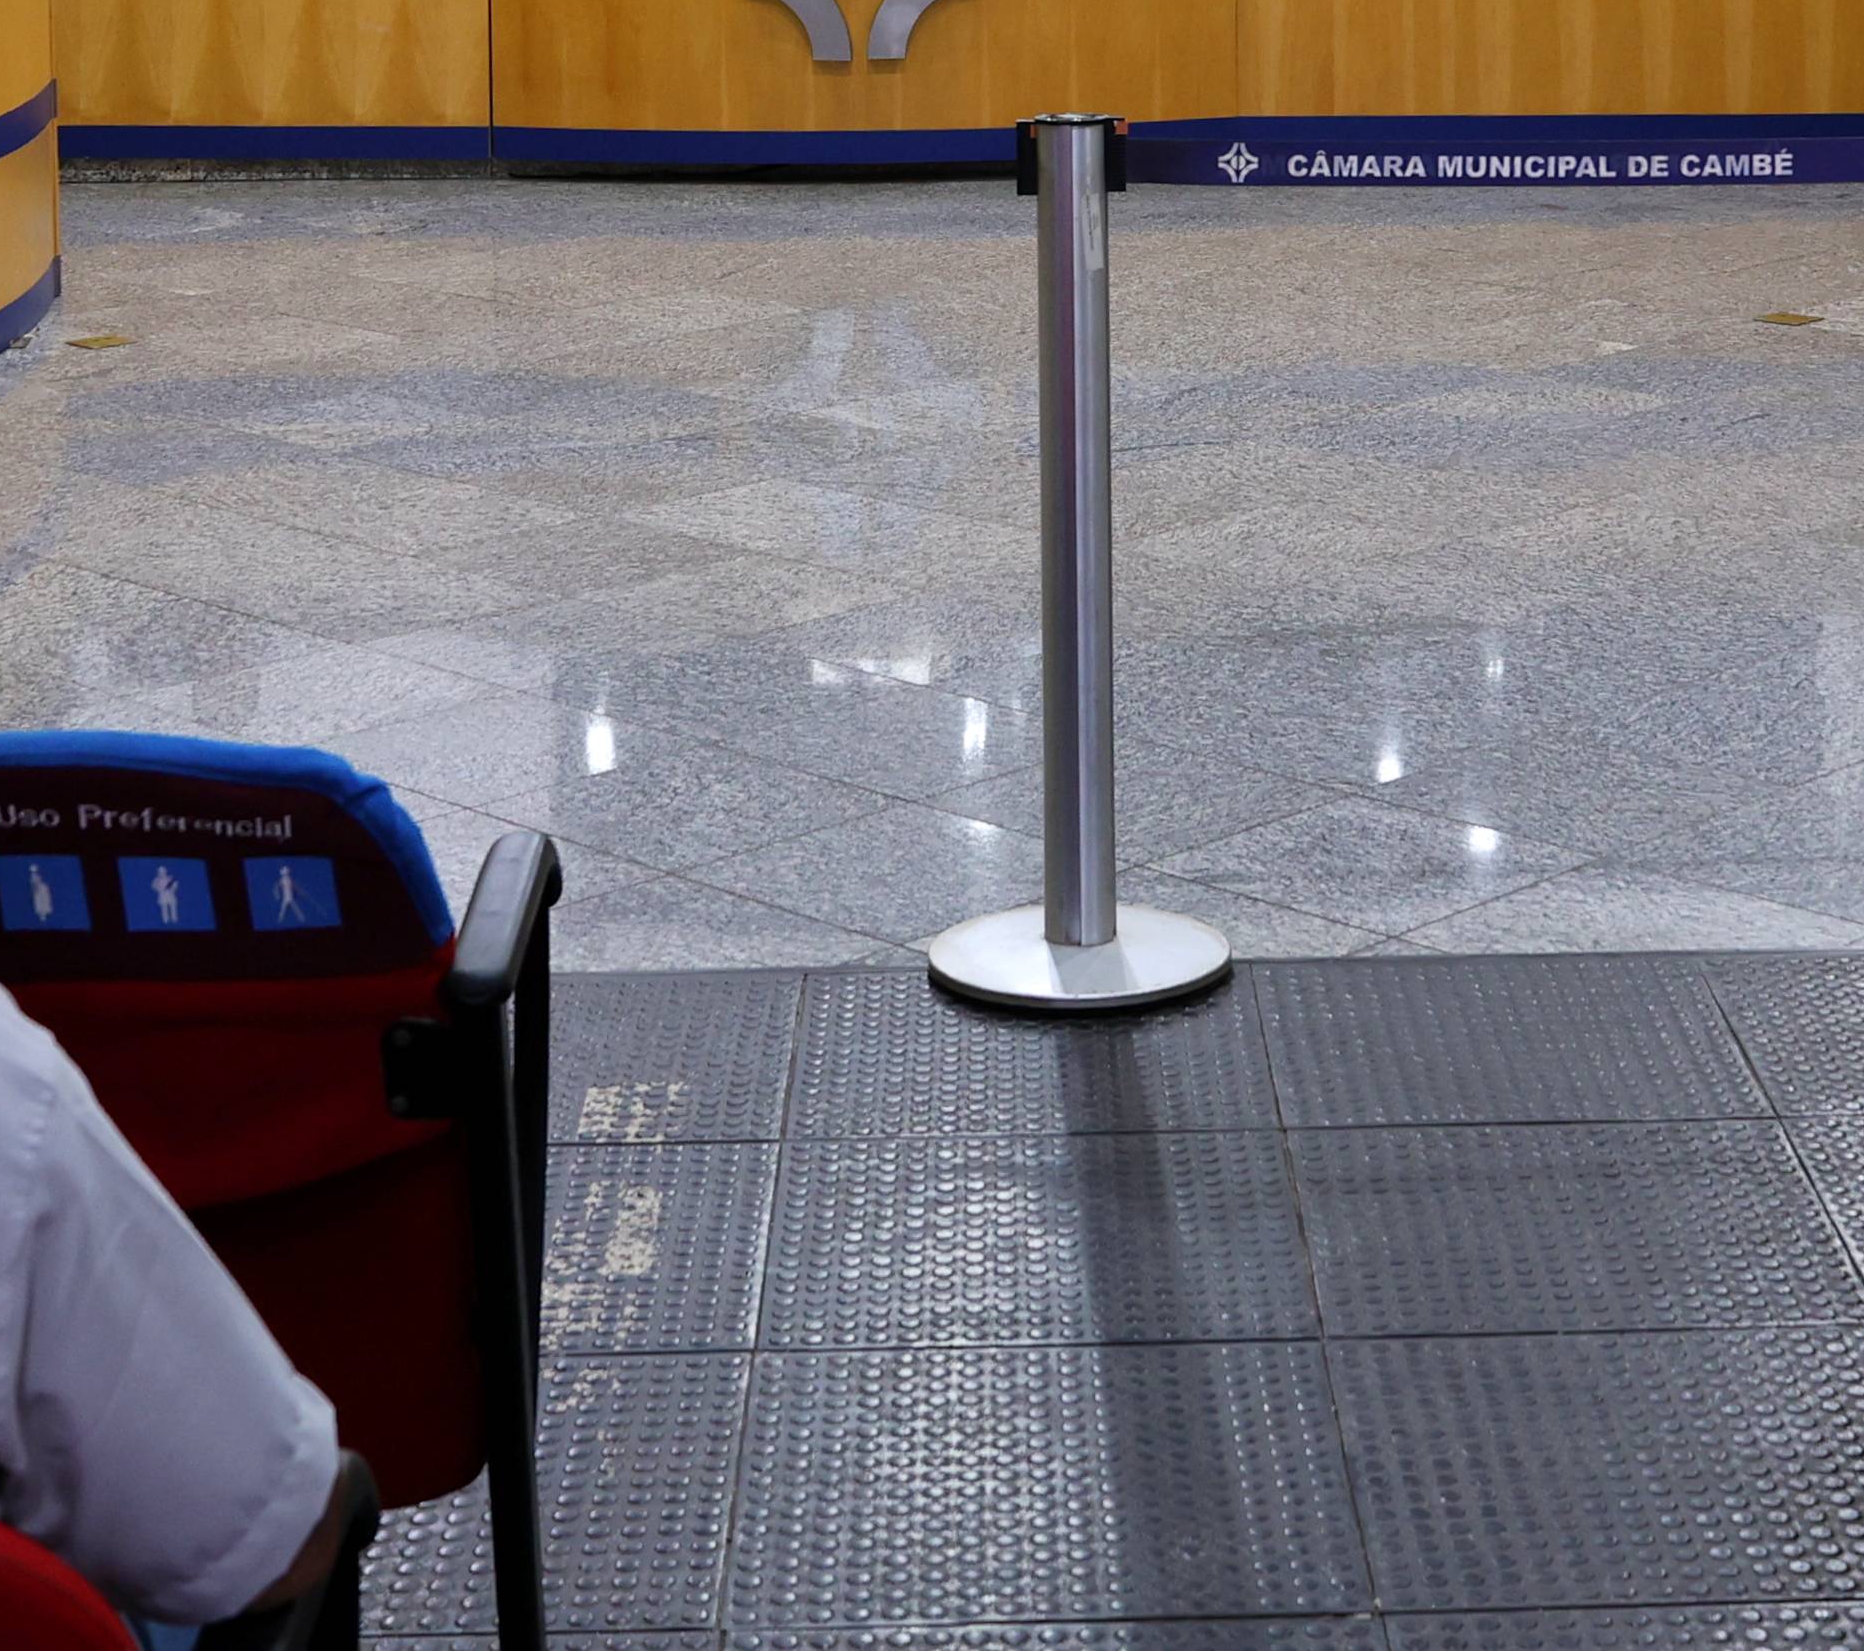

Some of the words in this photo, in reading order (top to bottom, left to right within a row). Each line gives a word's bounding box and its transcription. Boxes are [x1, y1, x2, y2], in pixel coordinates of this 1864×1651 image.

[1287, 150, 1427, 178] CÂMARA
[1437, 155, 1617, 179] MUNICIPAL
[1627, 155, 1669, 178] DE
[1680, 148, 1794, 177] CAMBÉ
